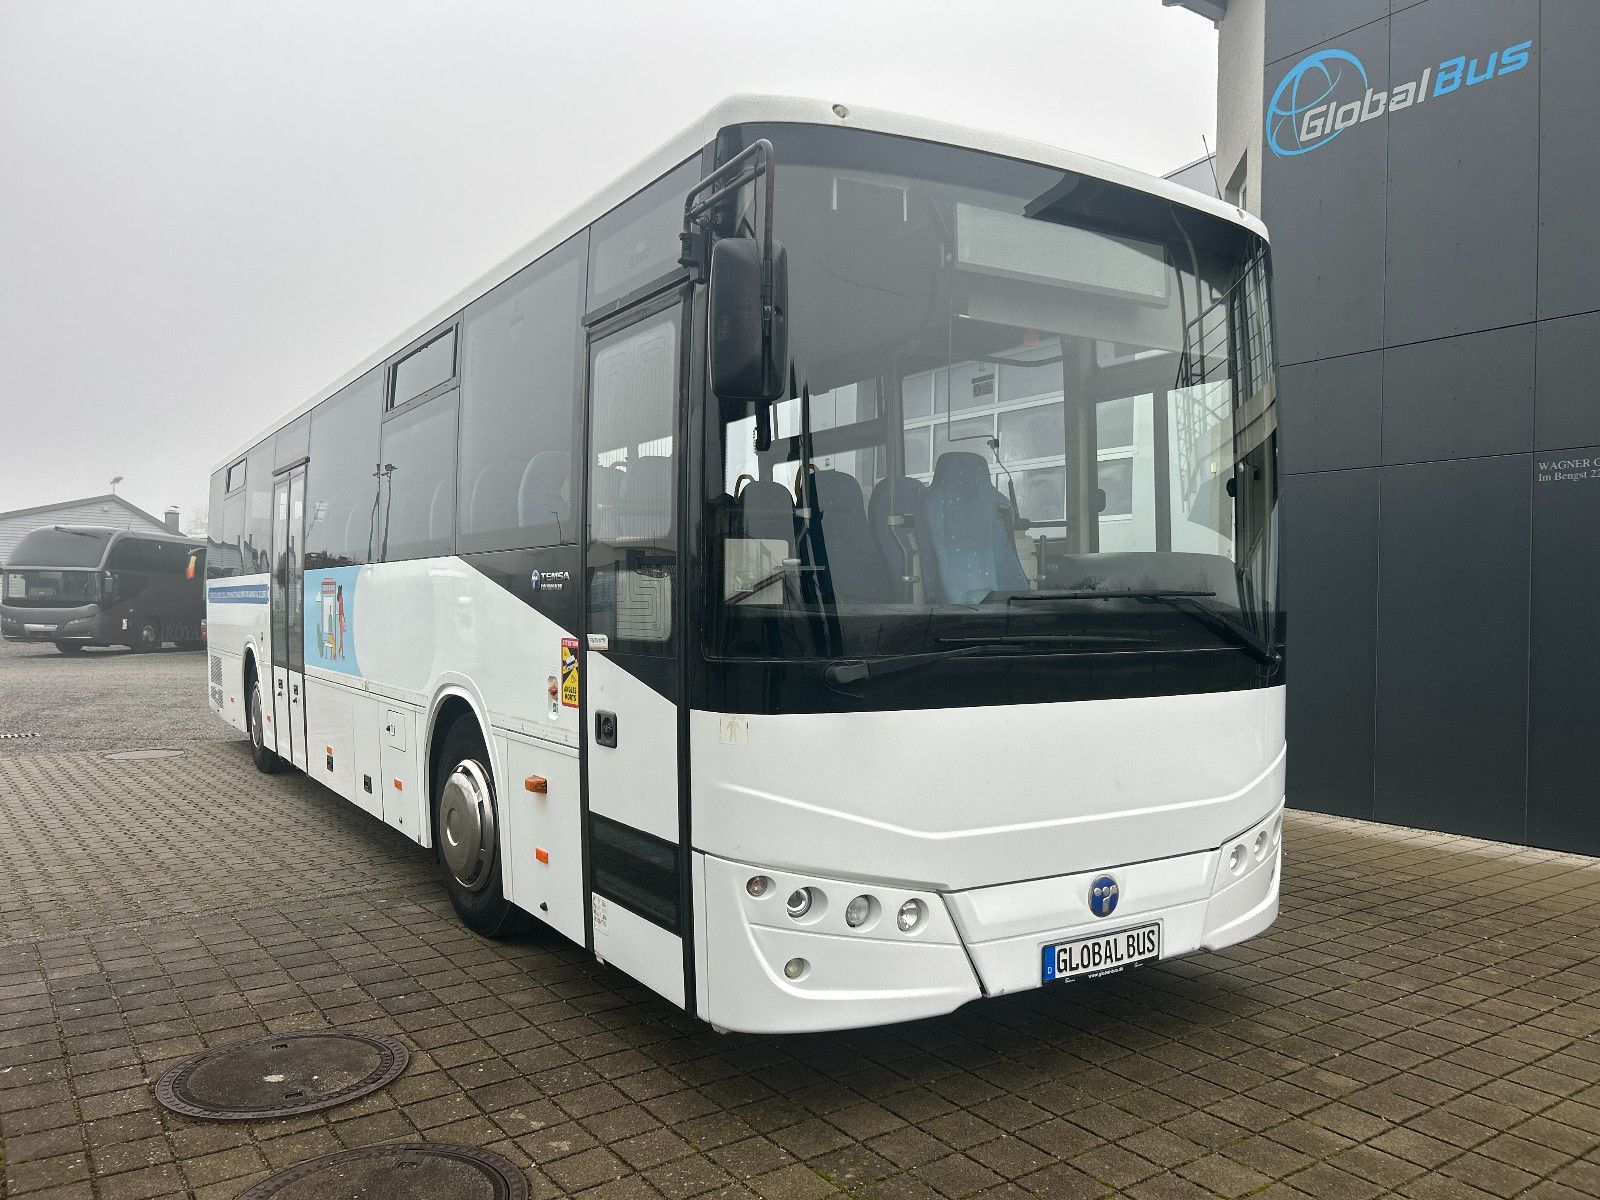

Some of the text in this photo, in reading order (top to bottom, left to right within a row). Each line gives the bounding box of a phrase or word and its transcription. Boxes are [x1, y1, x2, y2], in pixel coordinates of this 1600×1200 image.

[1538, 459, 1590, 470] WAGNER
[1538, 473, 1552, 481] Im
[1555, 472, 1587, 481] Bengst
[540, 571, 570, 580] TEMSA
[1056, 929, 1156, 973] GLOBAL BUS
[1047, 966, 1053, 975] D
